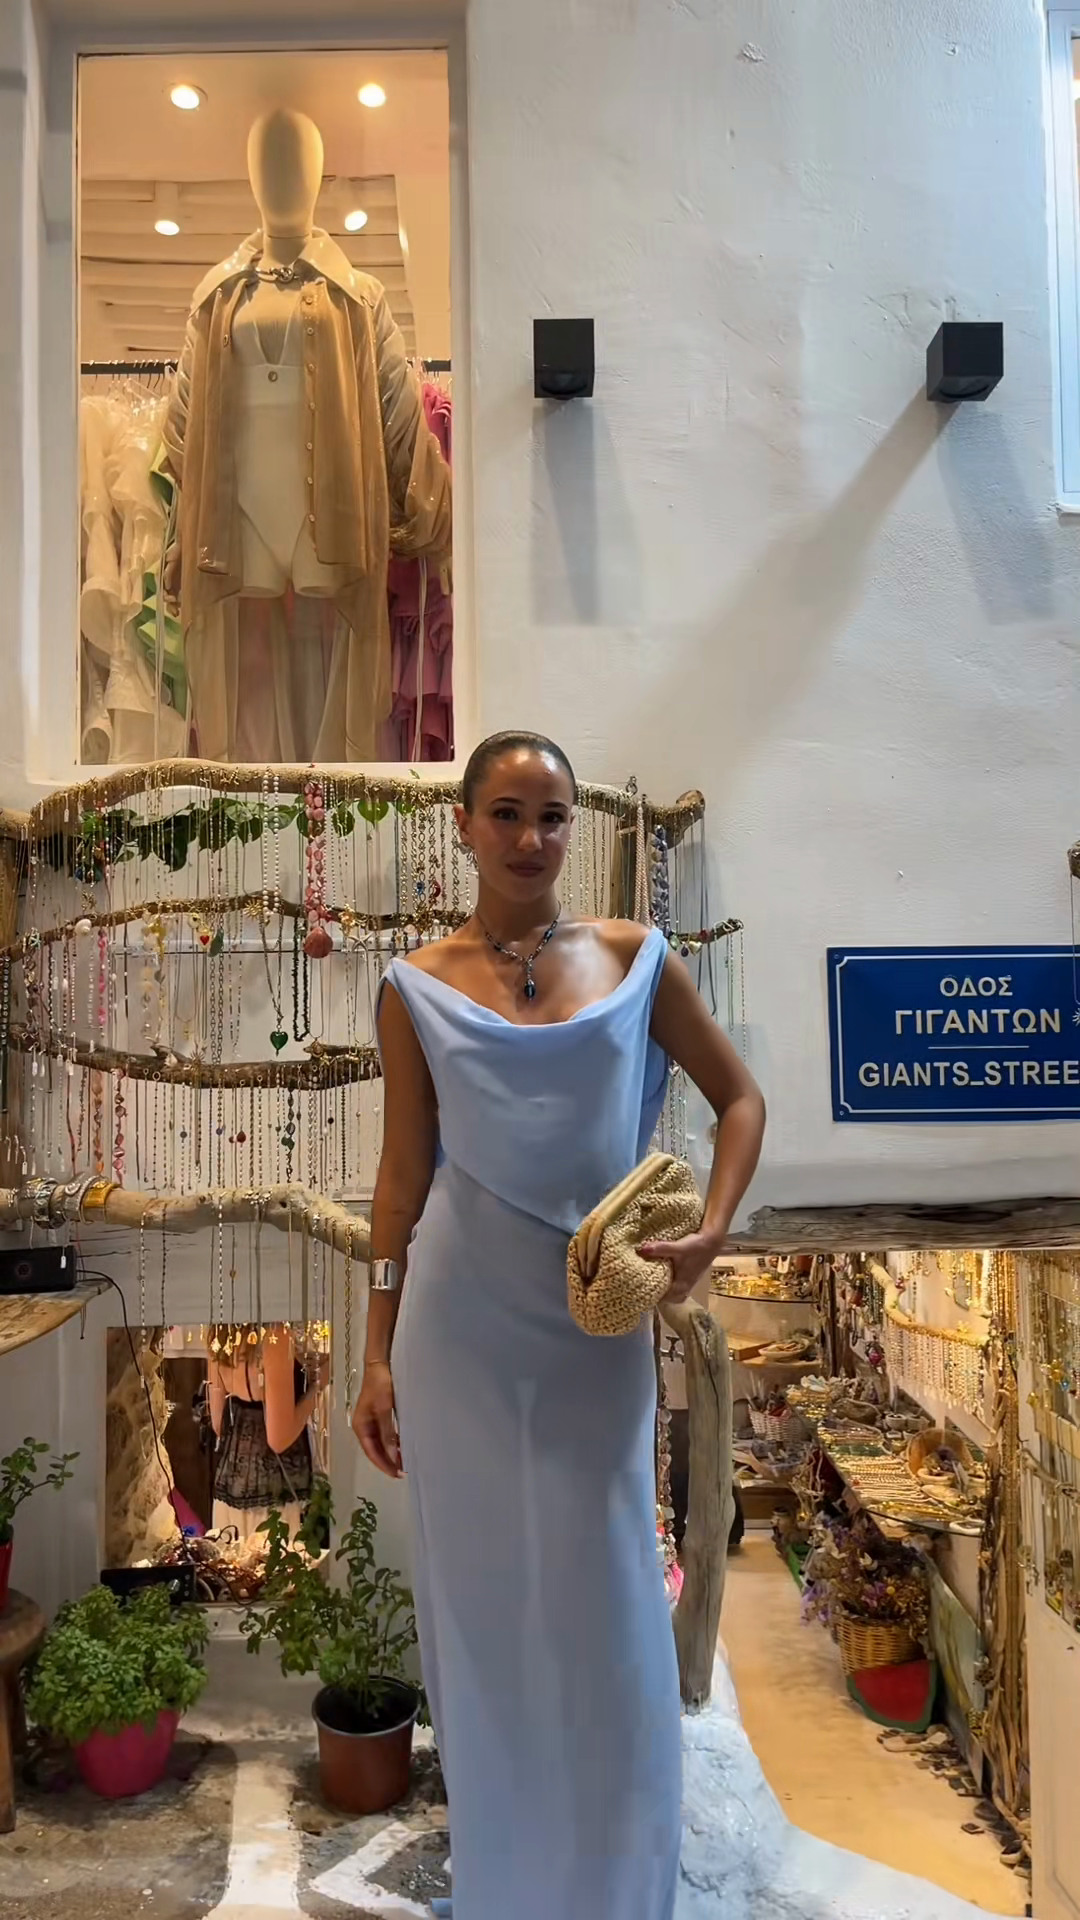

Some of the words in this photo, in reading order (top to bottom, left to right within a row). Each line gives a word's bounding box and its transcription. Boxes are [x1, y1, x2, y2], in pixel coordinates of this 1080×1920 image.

[939, 976, 1013, 997] ΟΔΟΣ
[895, 1008, 1061, 1035] ΓΙΓΑΝΤΩΝ
[858, 1060, 1080, 1087] GIANTS_STREE
